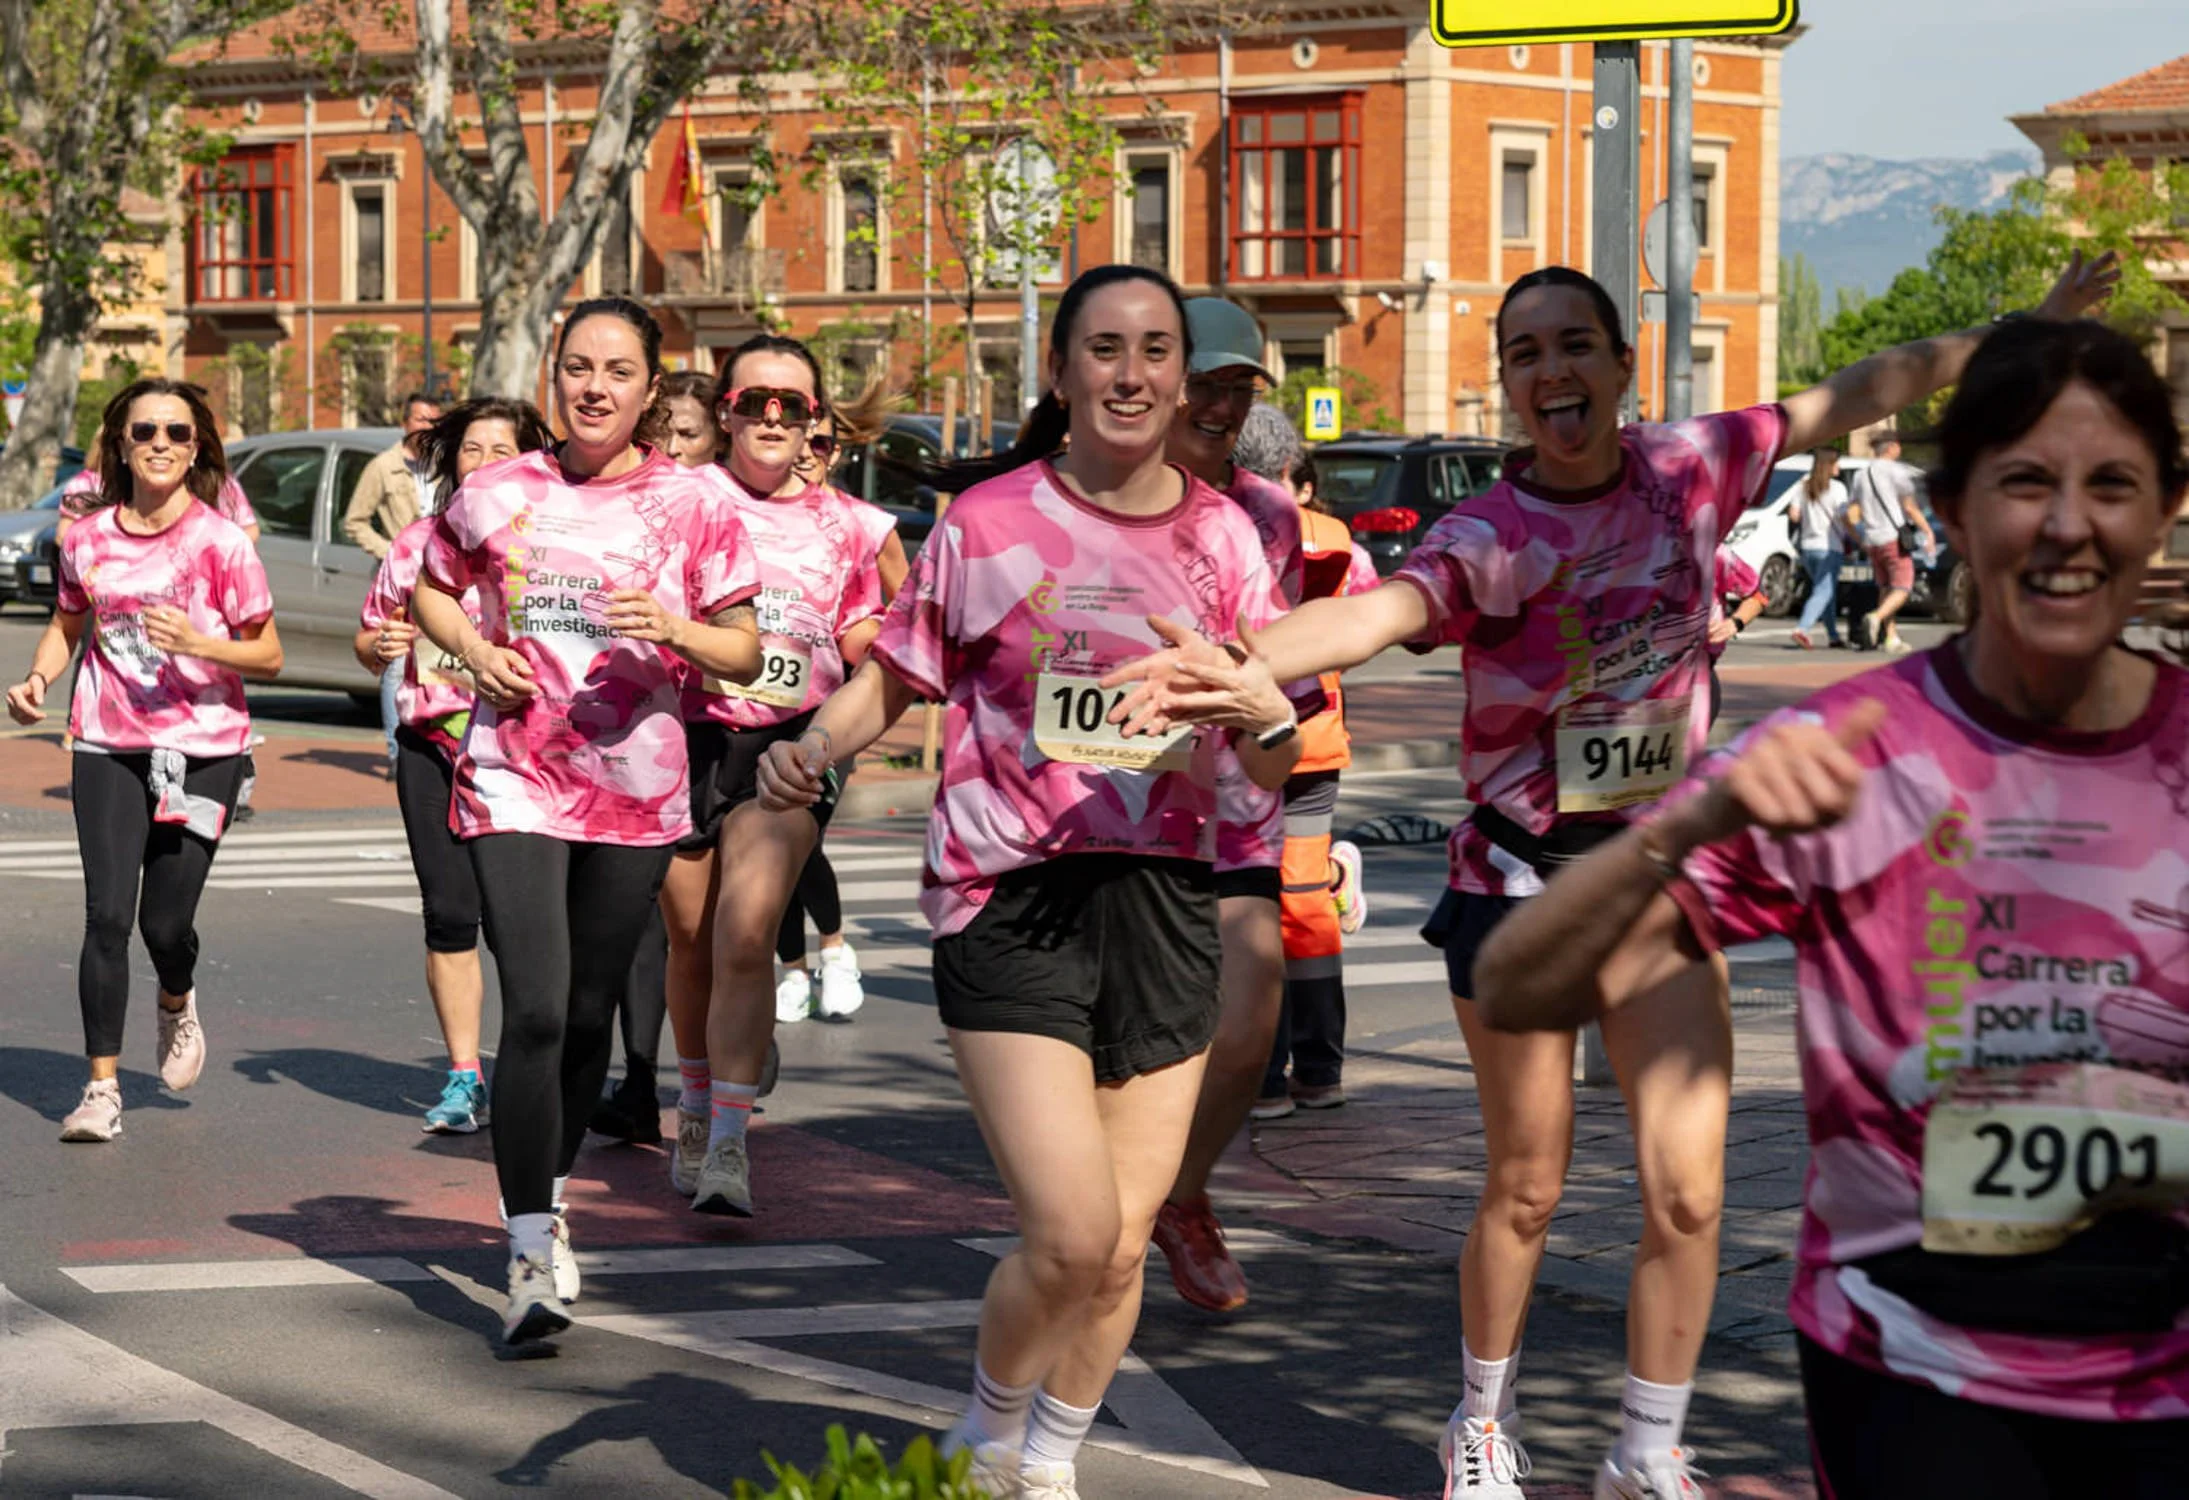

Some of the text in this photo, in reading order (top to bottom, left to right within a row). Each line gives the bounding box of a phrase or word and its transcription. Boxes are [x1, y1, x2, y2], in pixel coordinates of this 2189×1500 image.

[528, 546, 548, 563] XI
[525, 568, 600, 591] Carrera
[764, 586, 802, 602] rera
[524, 593, 578, 612] por la
[1061, 630, 1088, 652] XI
[767, 655, 802, 688] 93
[1583, 732, 1673, 781] 9144
[1974, 893, 2018, 932] XI
[1974, 945, 2131, 988] Carrera
[1912, 887, 1980, 1083] mujer
[1974, 996, 2088, 1042] por la
[1972, 1122, 2159, 1200] 2901
